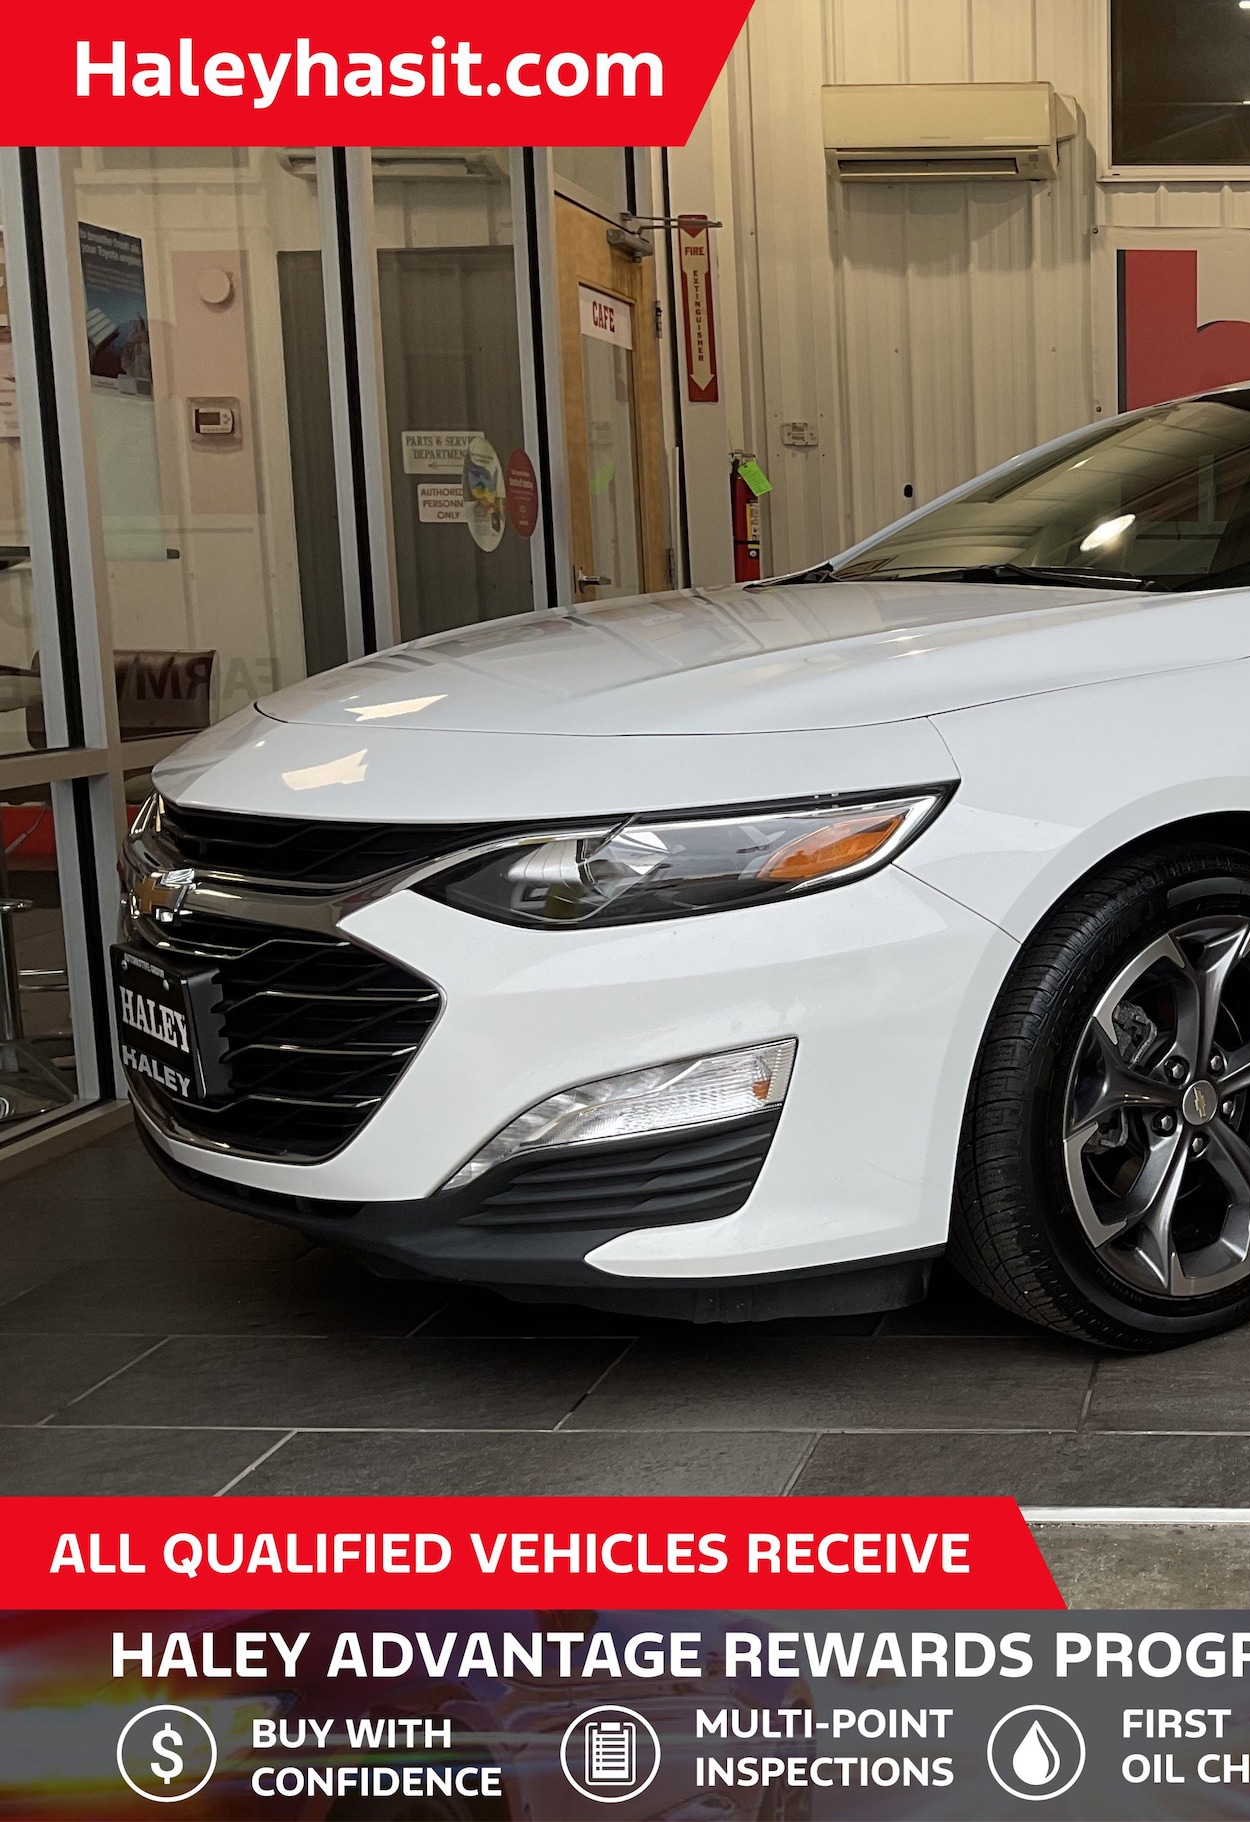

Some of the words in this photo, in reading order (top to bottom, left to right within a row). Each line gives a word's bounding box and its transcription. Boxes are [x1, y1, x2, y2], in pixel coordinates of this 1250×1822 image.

[684, 246, 705, 256] FIRE
[592, 301, 615, 333] CAFE
[693, 269, 704, 362] EXTINGUISHER
[405, 436, 432, 447] PARTS
[435, 436, 443, 447] &
[445, 436, 475, 447] SERVI
[413, 449, 466, 459] DEPARTMEN
[421, 488, 463, 496] AUTHORIZ
[422, 500, 464, 508] PERSONN
[437, 511, 460, 519] ONLY
[120, 986, 189, 1053] HALEY
[122, 1046, 190, 1097] HALEY
